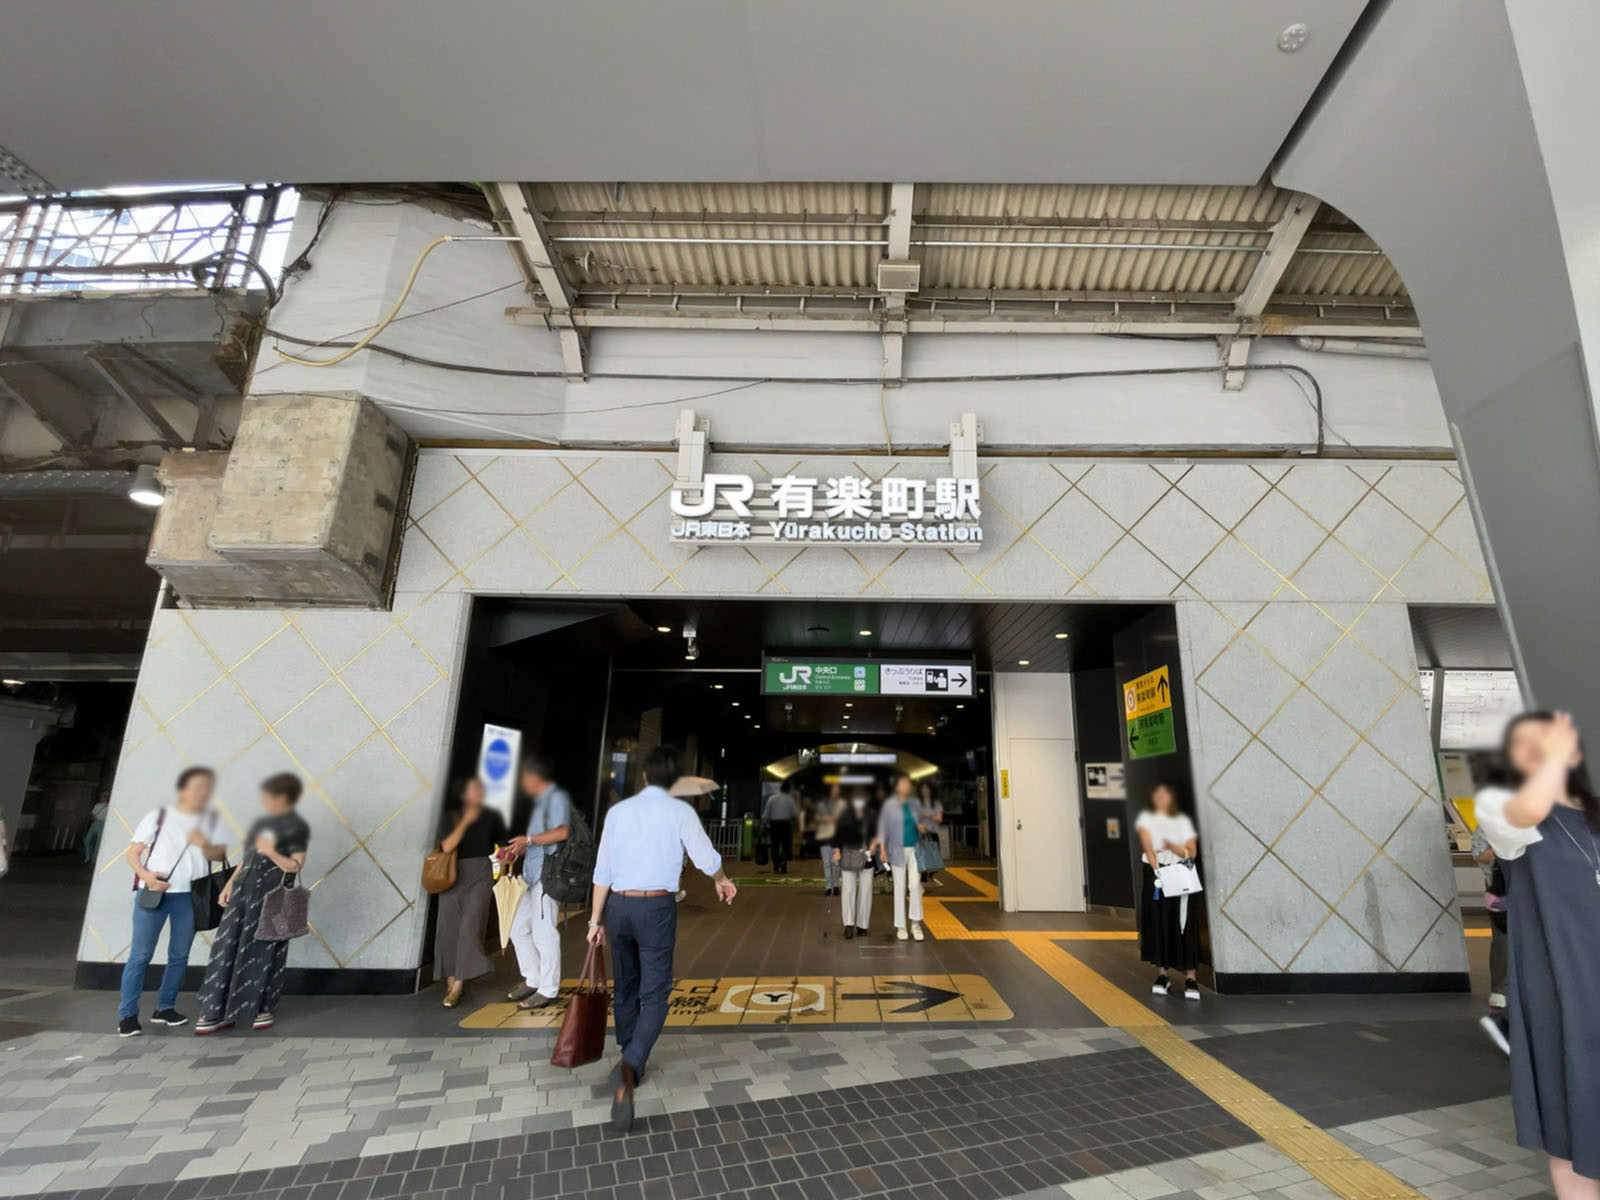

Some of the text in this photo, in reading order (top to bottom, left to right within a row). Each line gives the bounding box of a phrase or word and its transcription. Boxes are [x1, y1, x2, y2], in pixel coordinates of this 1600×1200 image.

[670, 473, 982, 521] JR 有楽町駅
[671, 521, 750, 539] JR東日本
[900, 522, 983, 542] Station
[779, 665, 812, 685] JR
[815, 666, 838, 675] 中央口
[885, 667, 924, 676] きっぷうりば
[763, 993, 785, 1003] Y
